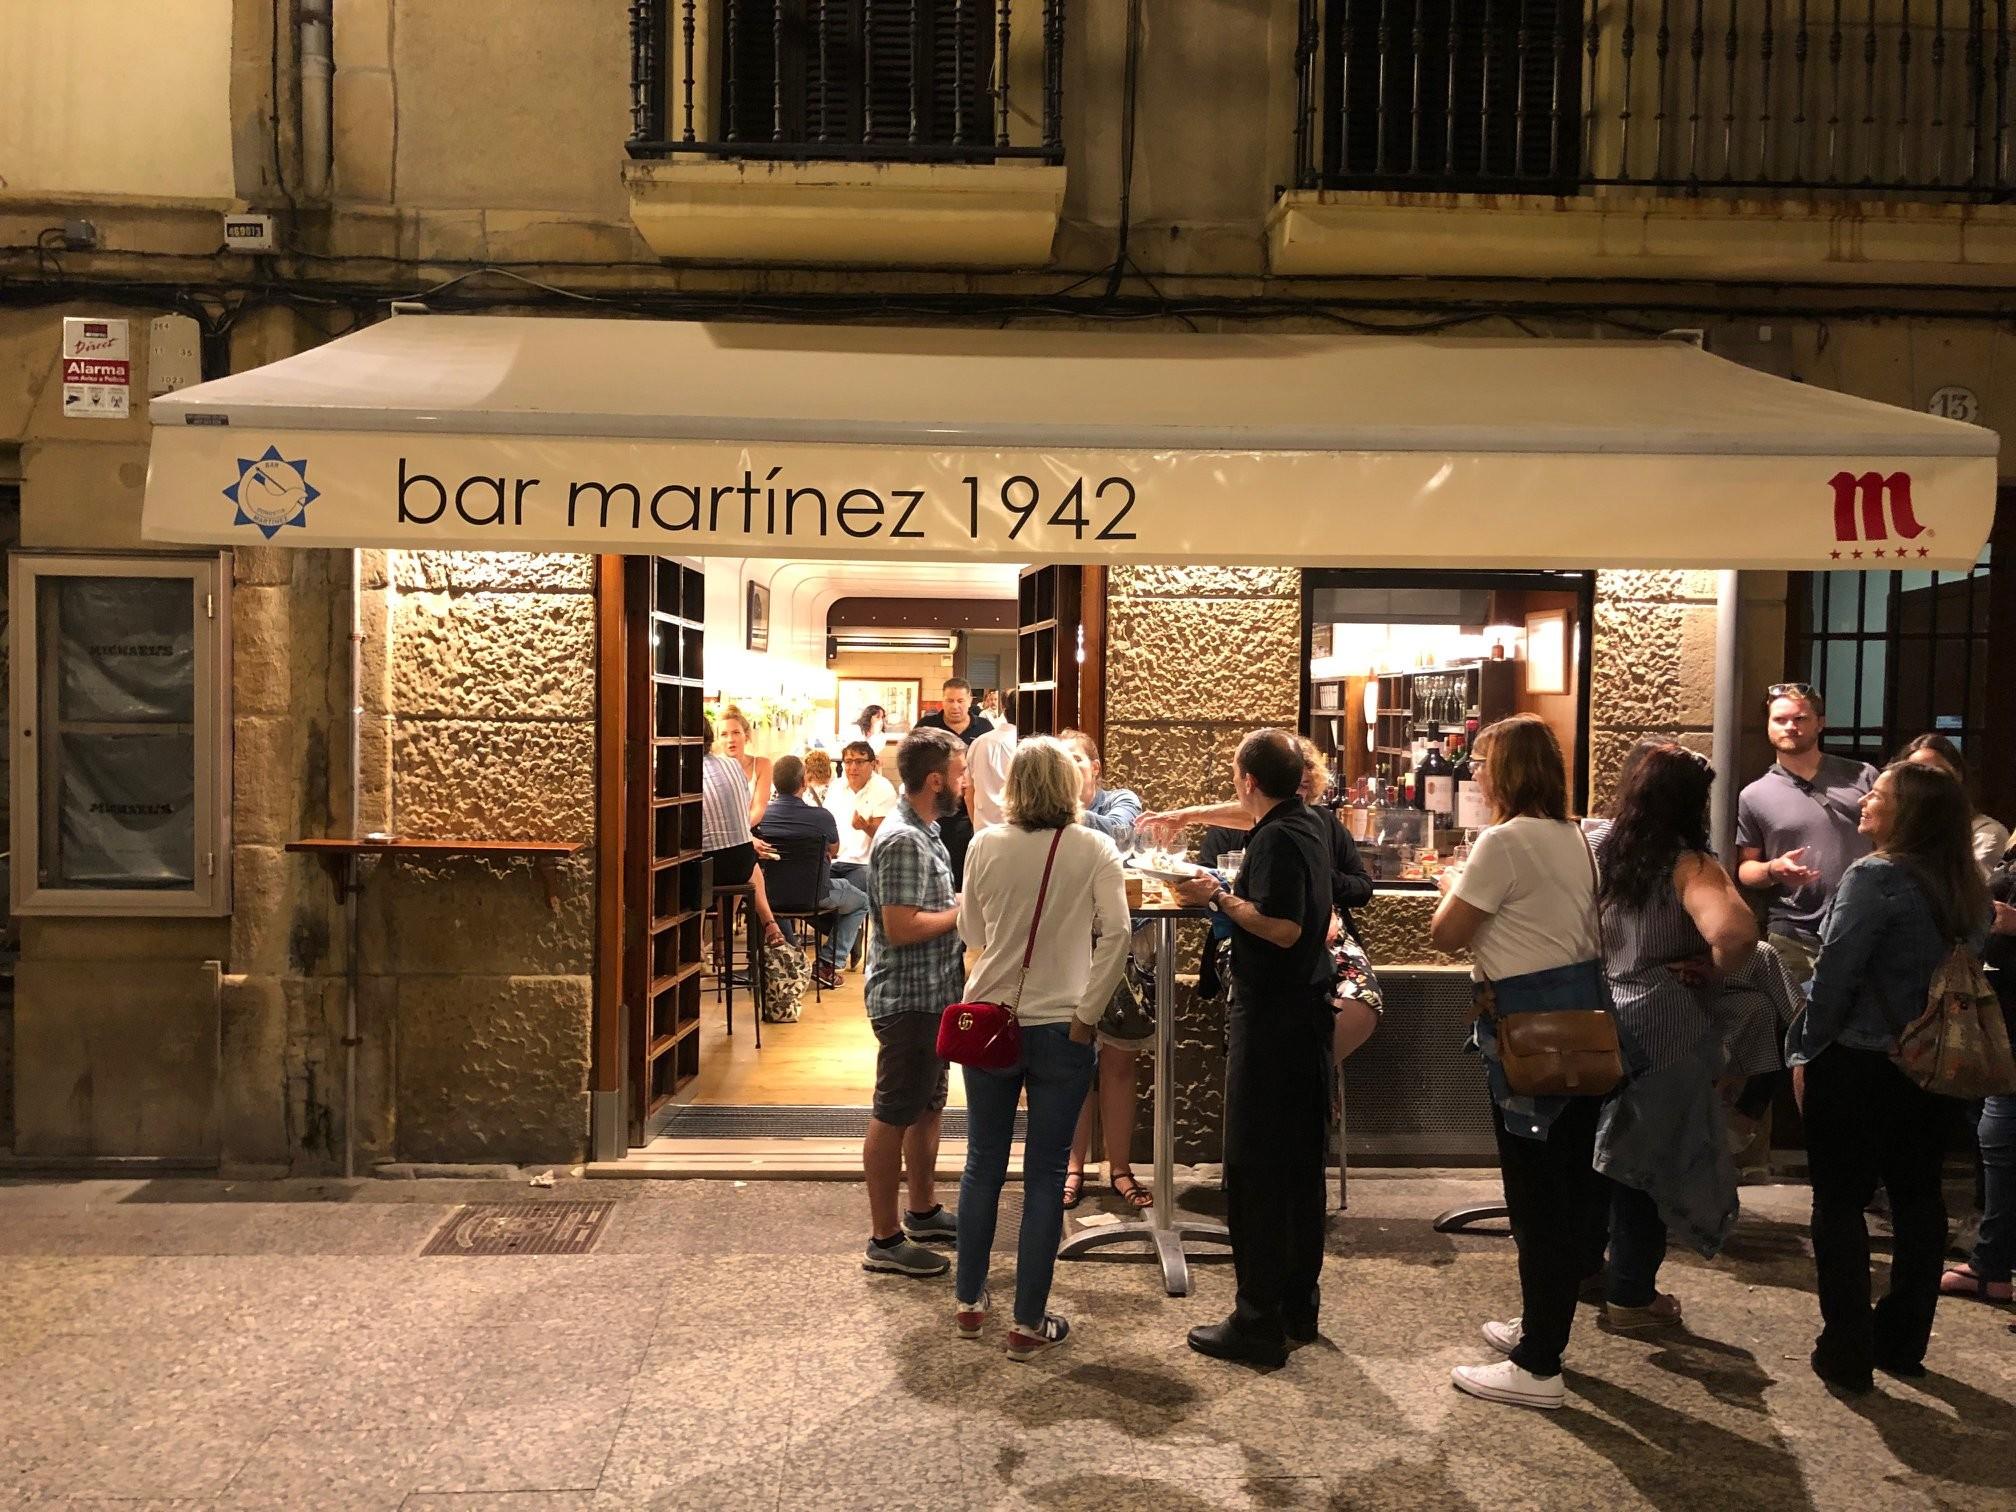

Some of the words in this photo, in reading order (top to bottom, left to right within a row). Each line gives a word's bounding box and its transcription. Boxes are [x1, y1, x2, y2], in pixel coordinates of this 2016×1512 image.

[74, 338, 118, 354] Direct
[67, 362, 126, 376] Alarma
[1935, 393, 1969, 421] 13
[398, 457, 541, 526] bar
[567, 466, 926, 538] martínez
[961, 475, 1137, 540] 1942
